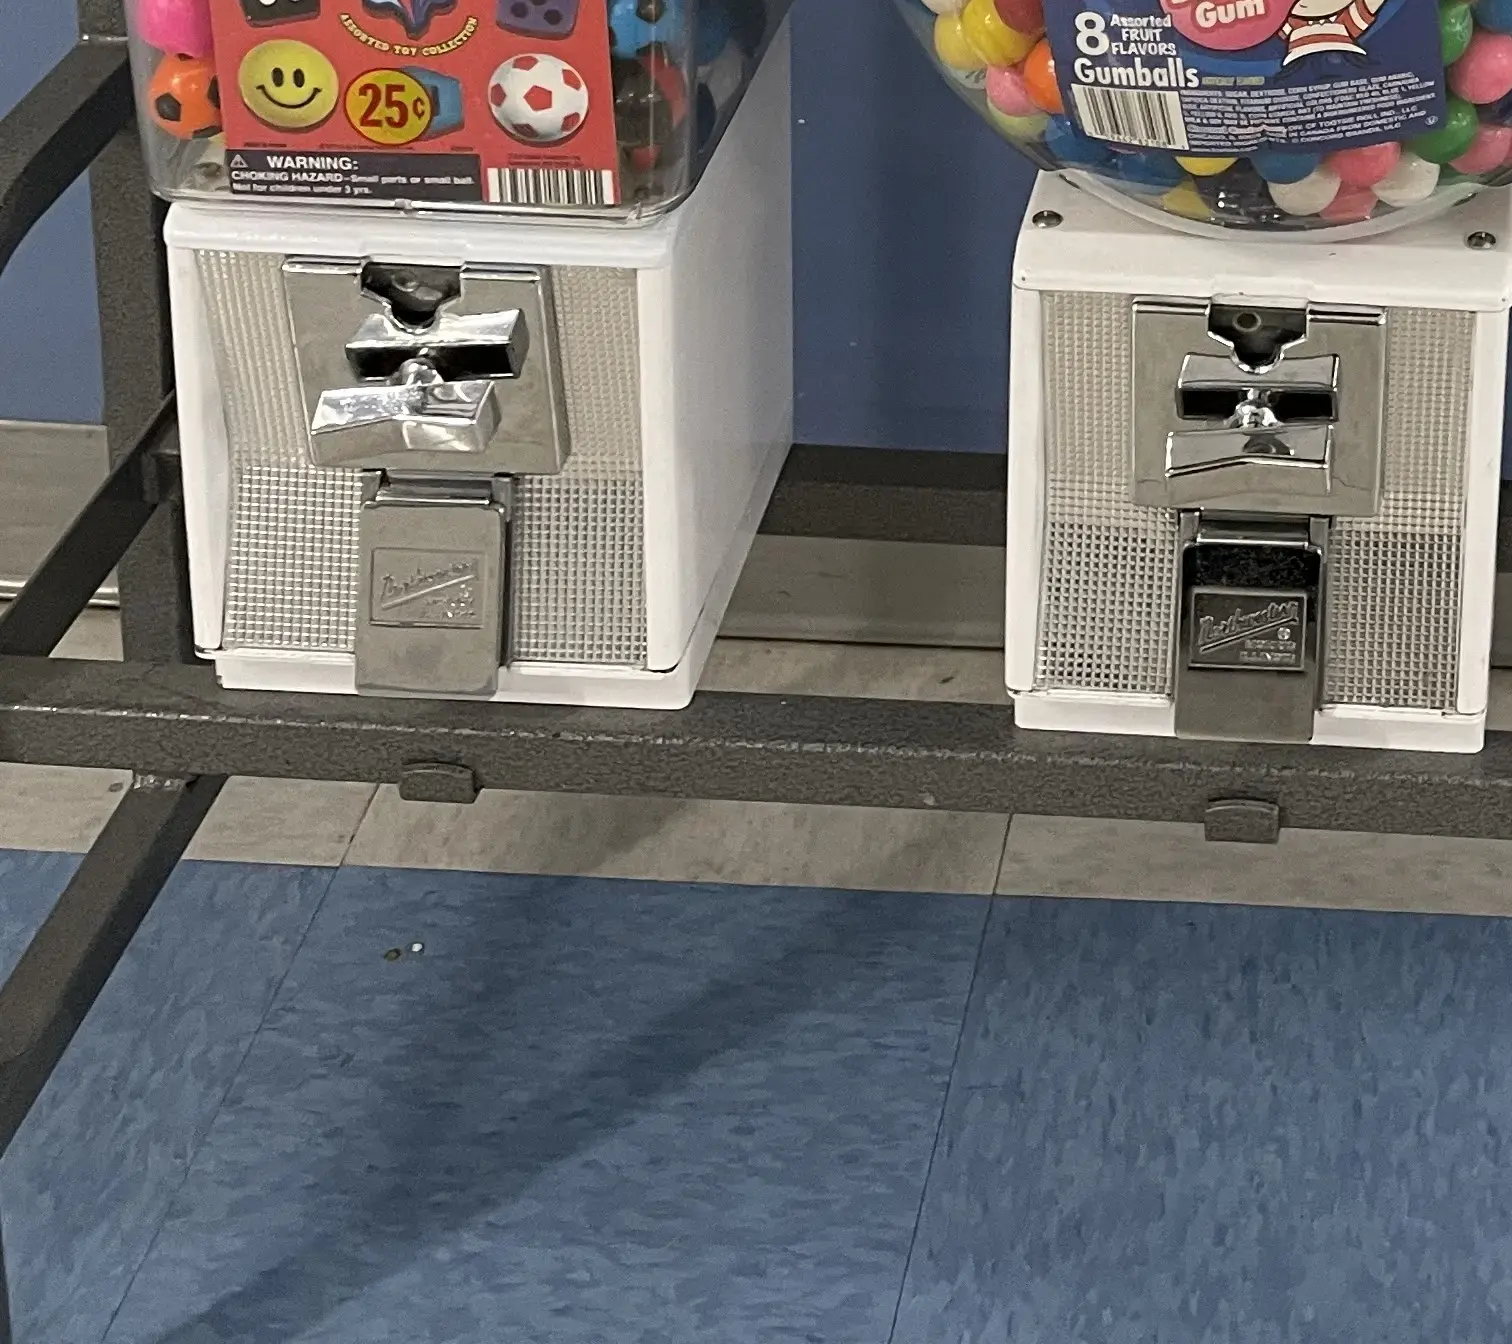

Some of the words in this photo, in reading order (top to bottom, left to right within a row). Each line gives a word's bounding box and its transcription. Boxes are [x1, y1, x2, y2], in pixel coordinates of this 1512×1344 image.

[1110, 14, 1172, 28] Assorted
[339, 13, 390, 51] ASSORTED
[393, 45, 418, 56] TOY
[422, 17, 478, 56] COLLECTION
[1074, 12, 1110, 56] 8
[1121, 28, 1162, 42] FRUIT
[1111, 42, 1177, 56] FLAVORS
[1074, 58, 1199, 89] Gumballs
[358, 83, 426, 128] 25¢
[267, 155, 359, 171] WARNING:
[231, 170, 289, 182] CHOKING
